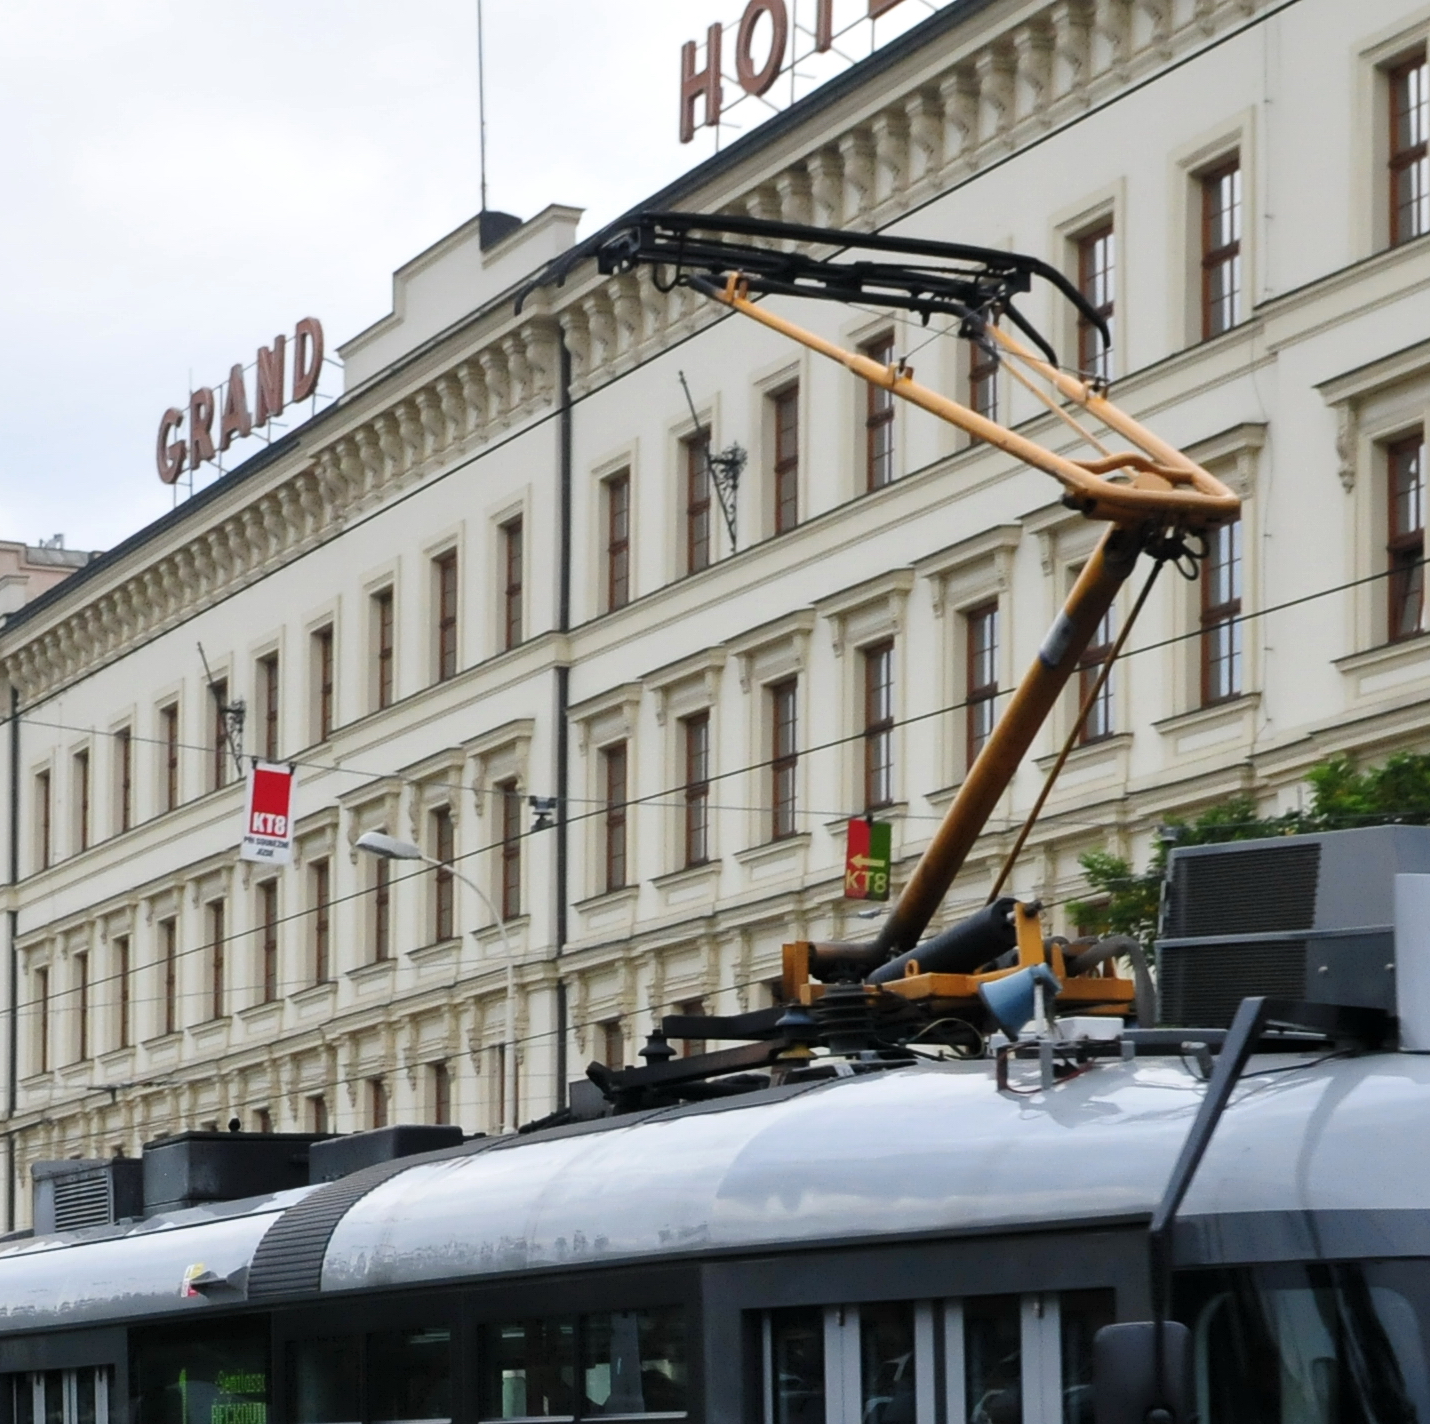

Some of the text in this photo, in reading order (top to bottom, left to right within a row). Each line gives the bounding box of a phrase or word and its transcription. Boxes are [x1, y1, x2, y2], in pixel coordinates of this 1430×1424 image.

[156, 0, 907, 485] GRAND HO
[252, 811, 287, 835] KT8
[846, 869, 887, 893] KT8
